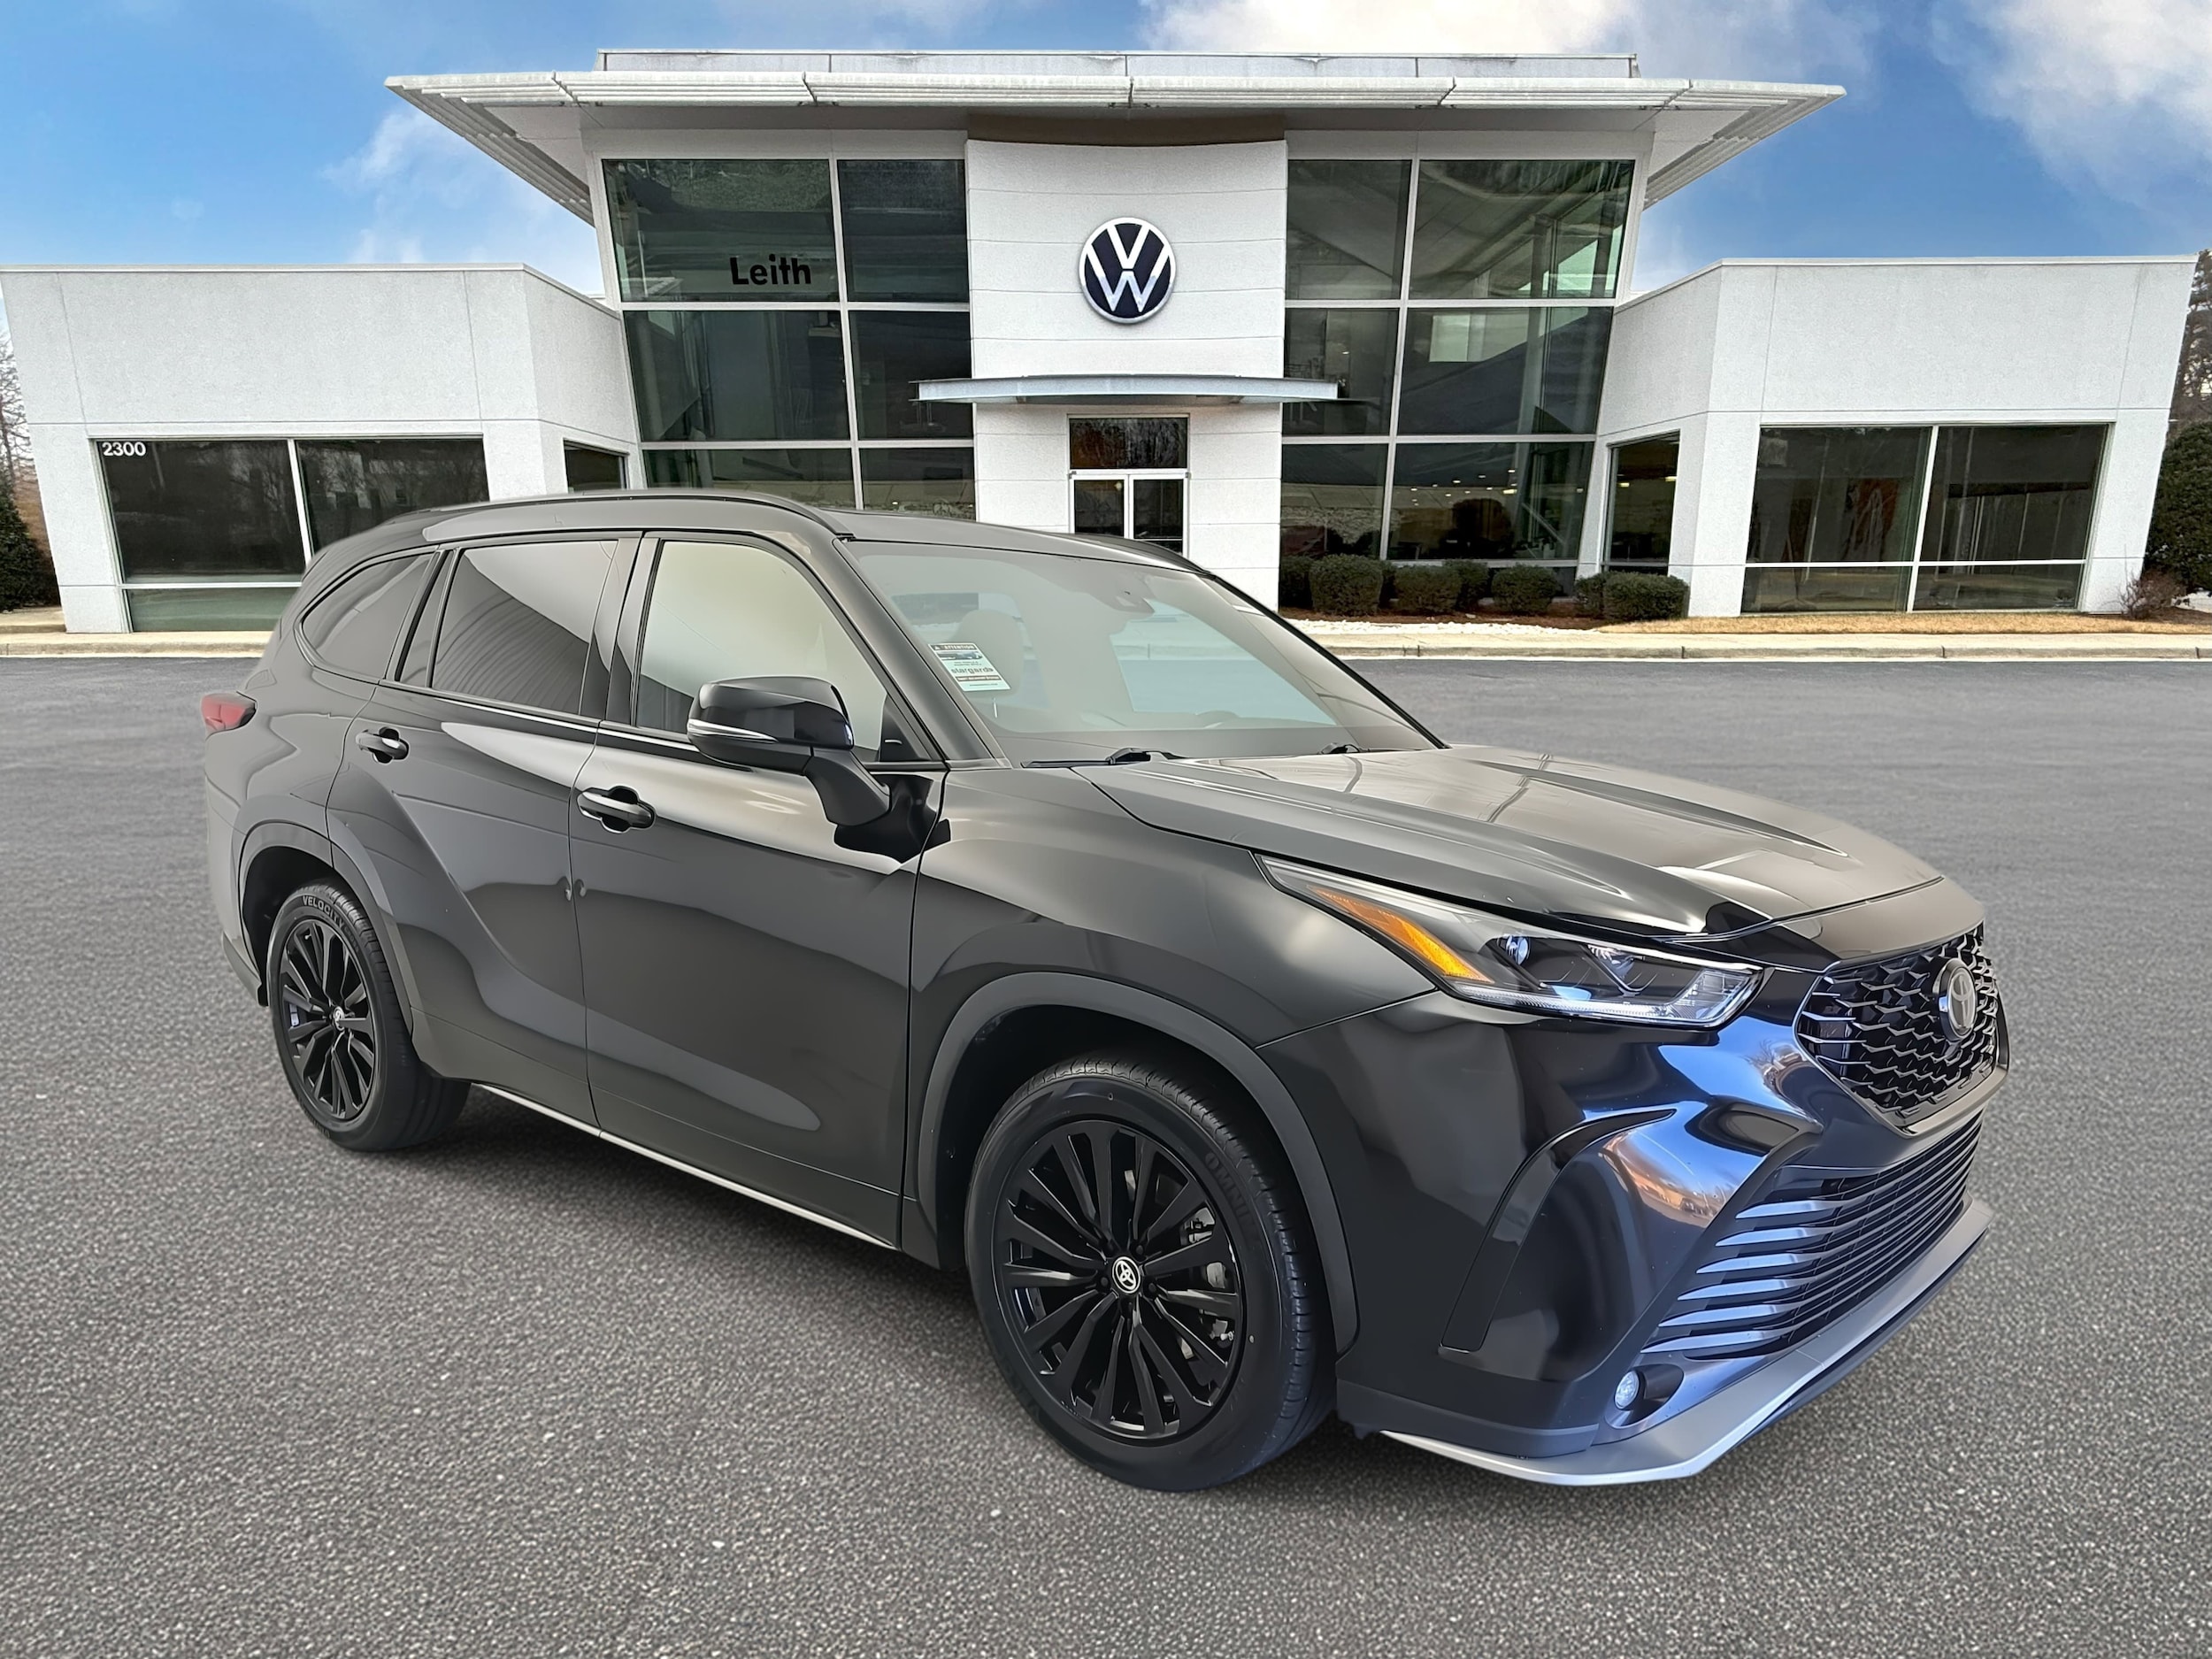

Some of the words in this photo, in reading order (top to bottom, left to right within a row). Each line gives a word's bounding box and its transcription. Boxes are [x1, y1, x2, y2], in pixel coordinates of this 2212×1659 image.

[730, 254, 811, 285] Leith
[102, 442, 146, 457] 2300
[303, 895, 344, 928] VELOCITY
